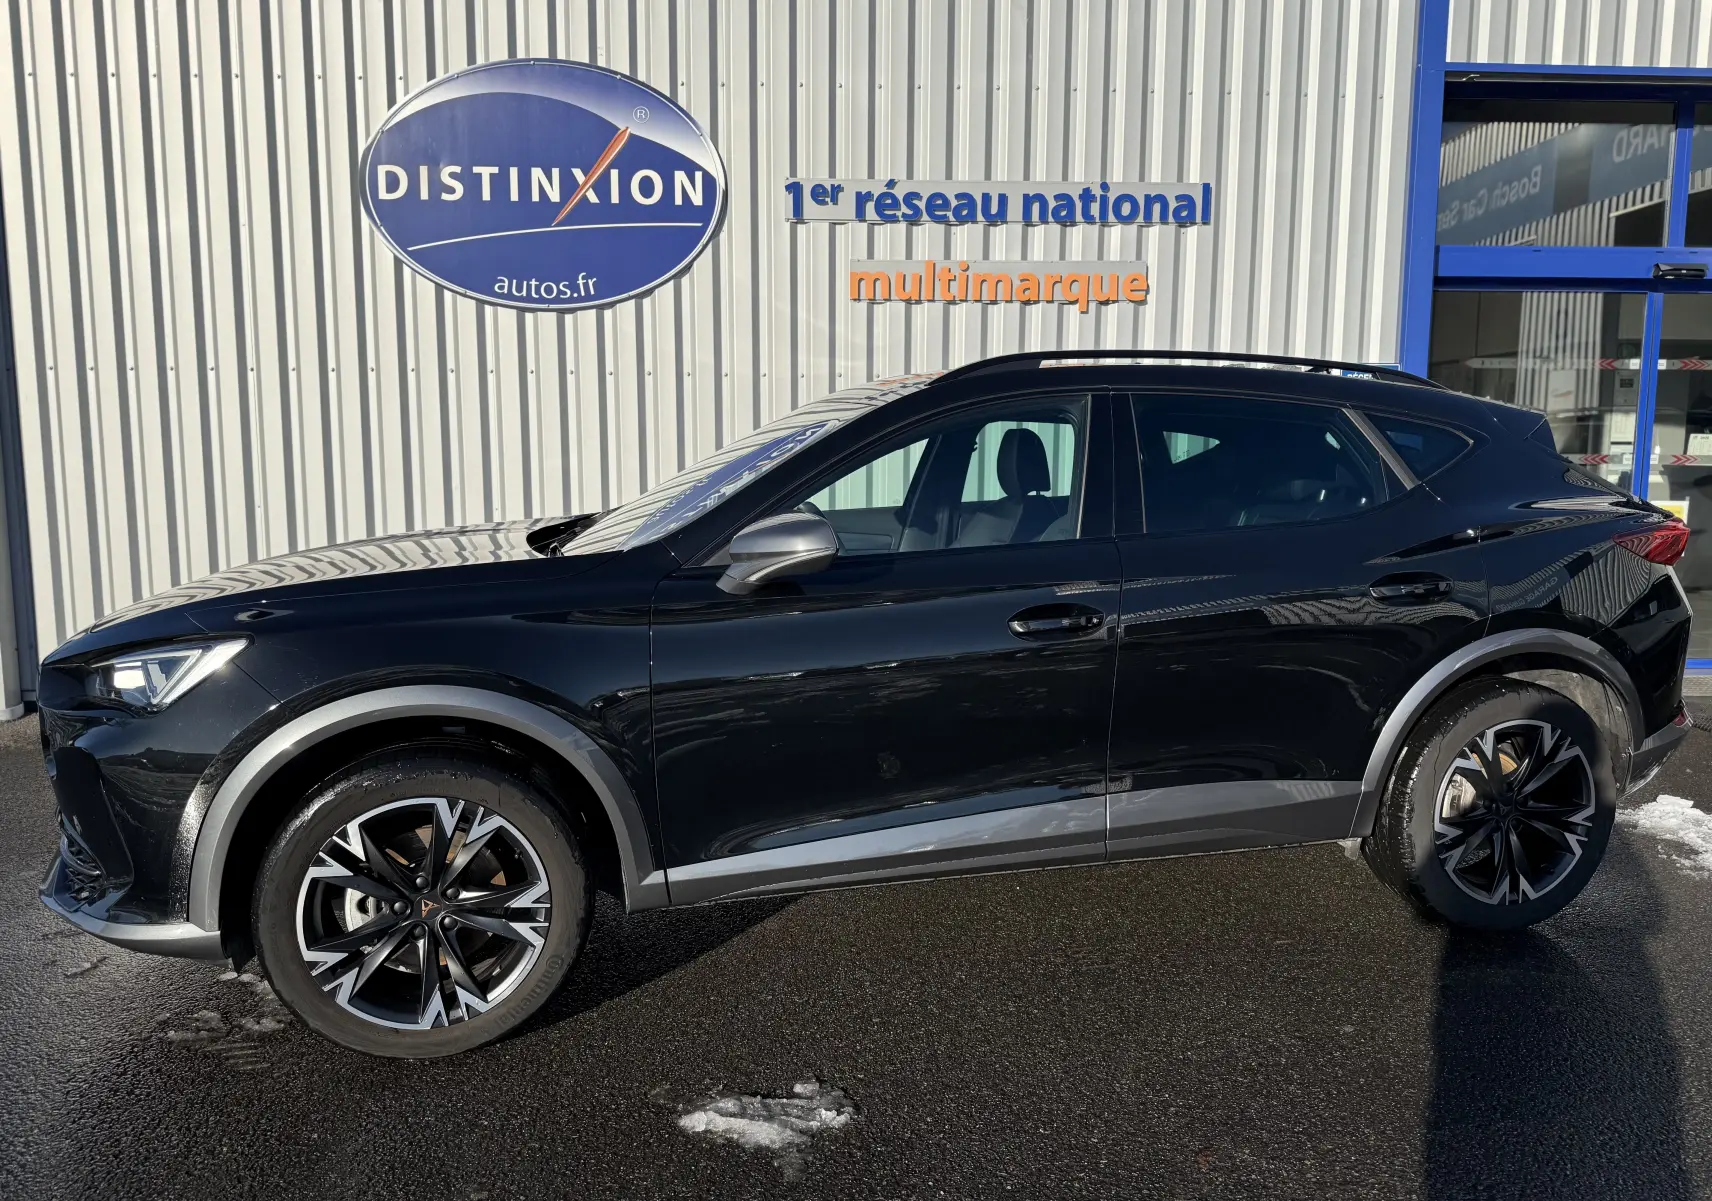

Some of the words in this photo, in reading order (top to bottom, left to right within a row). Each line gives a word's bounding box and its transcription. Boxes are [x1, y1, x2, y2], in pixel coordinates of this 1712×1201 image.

[377, 164, 704, 206] DISTINXION
[784, 181, 843, 220] 1er
[855, 179, 1008, 224] réseau
[1022, 182, 1212, 226] national
[494, 272, 597, 299] autos.fr
[850, 261, 1148, 313] multimarque
